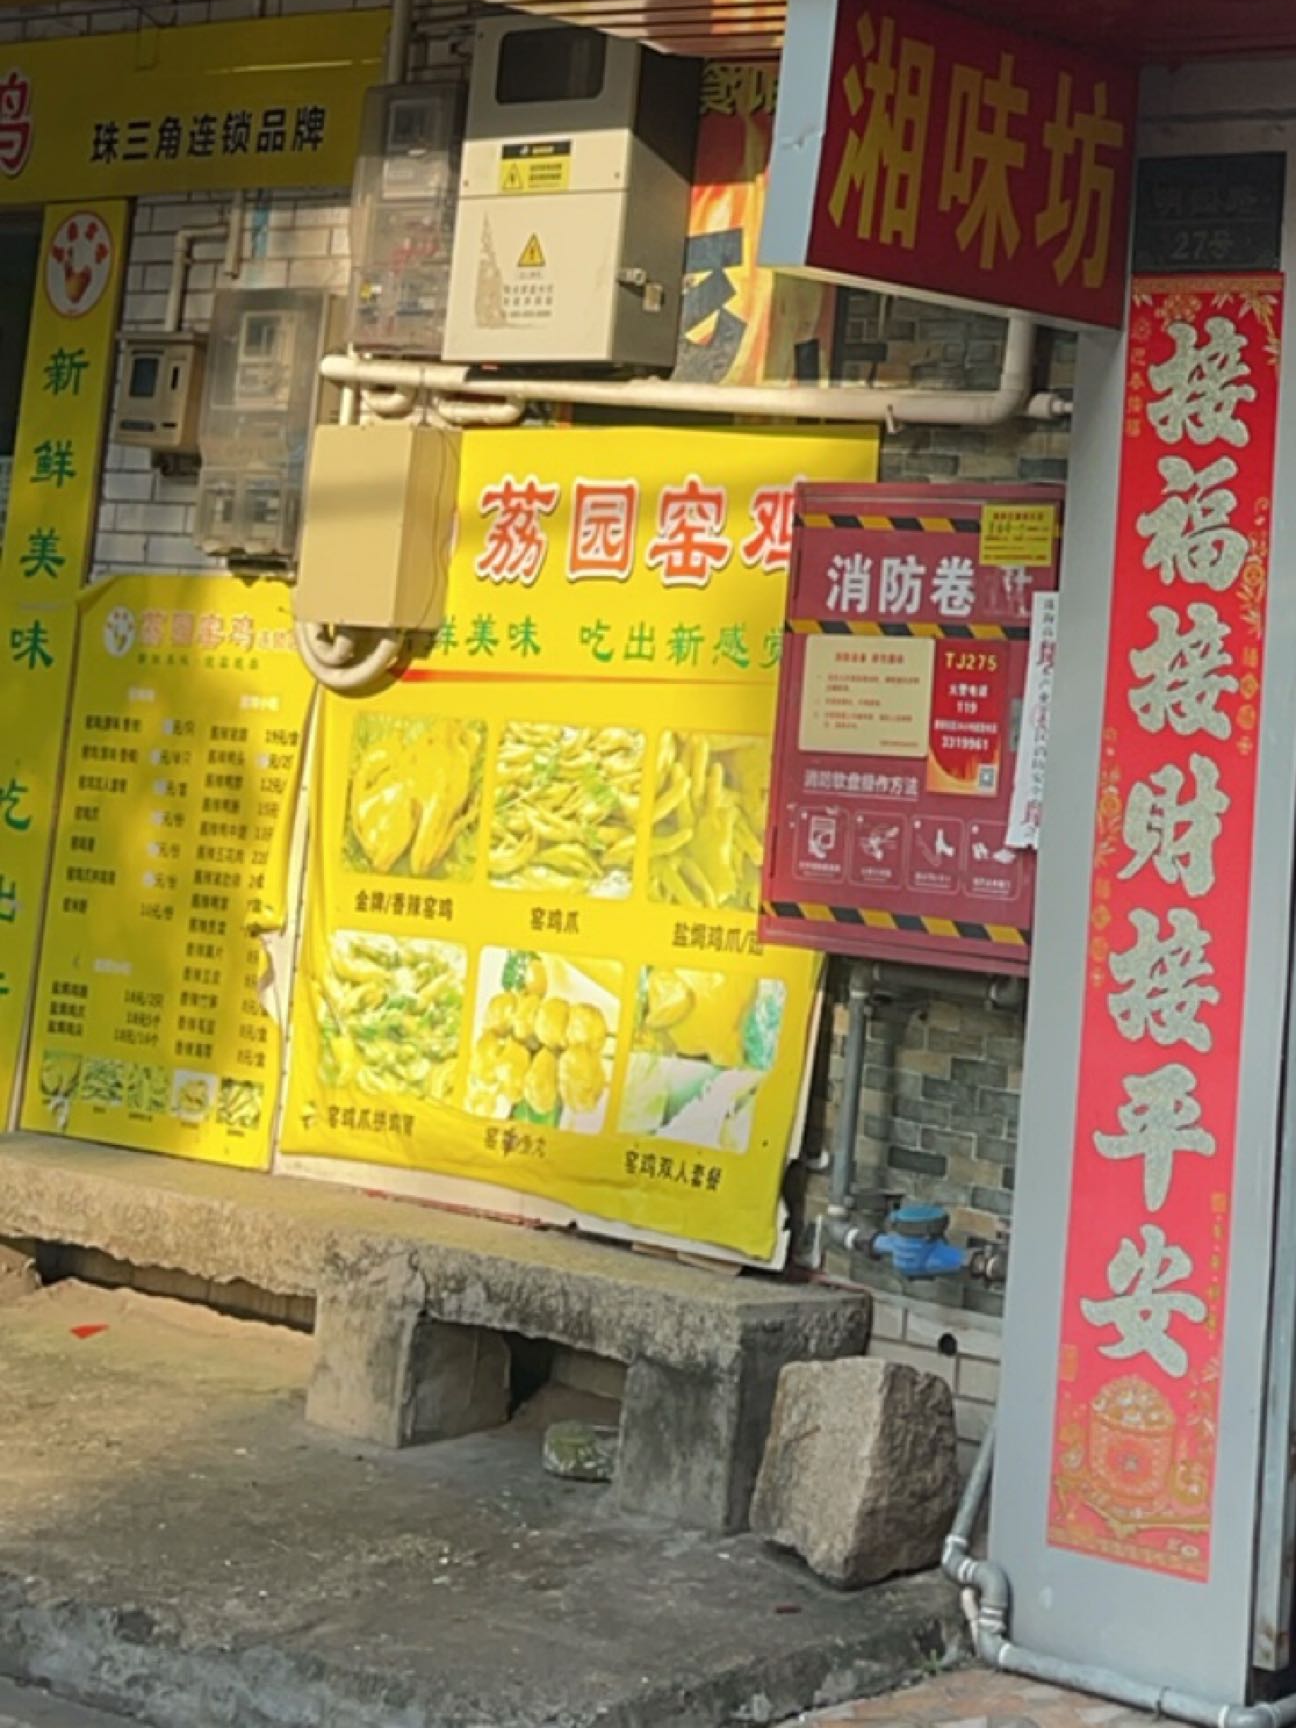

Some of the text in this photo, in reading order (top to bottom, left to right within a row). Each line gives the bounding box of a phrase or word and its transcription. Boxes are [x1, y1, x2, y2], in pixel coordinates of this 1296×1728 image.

[90, 105, 326, 164] 珠三角连锁品牌
[827, 10, 1124, 289] 湘味坊
[8, 347, 91, 669] 新鲜美味
[474, 474, 794, 588] 荔园窑鸡
[826, 550, 1032, 618] 消防卷
[945, 653, 998, 671] TJ275
[1078, 320, 1257, 1380] 接福接财接平安
